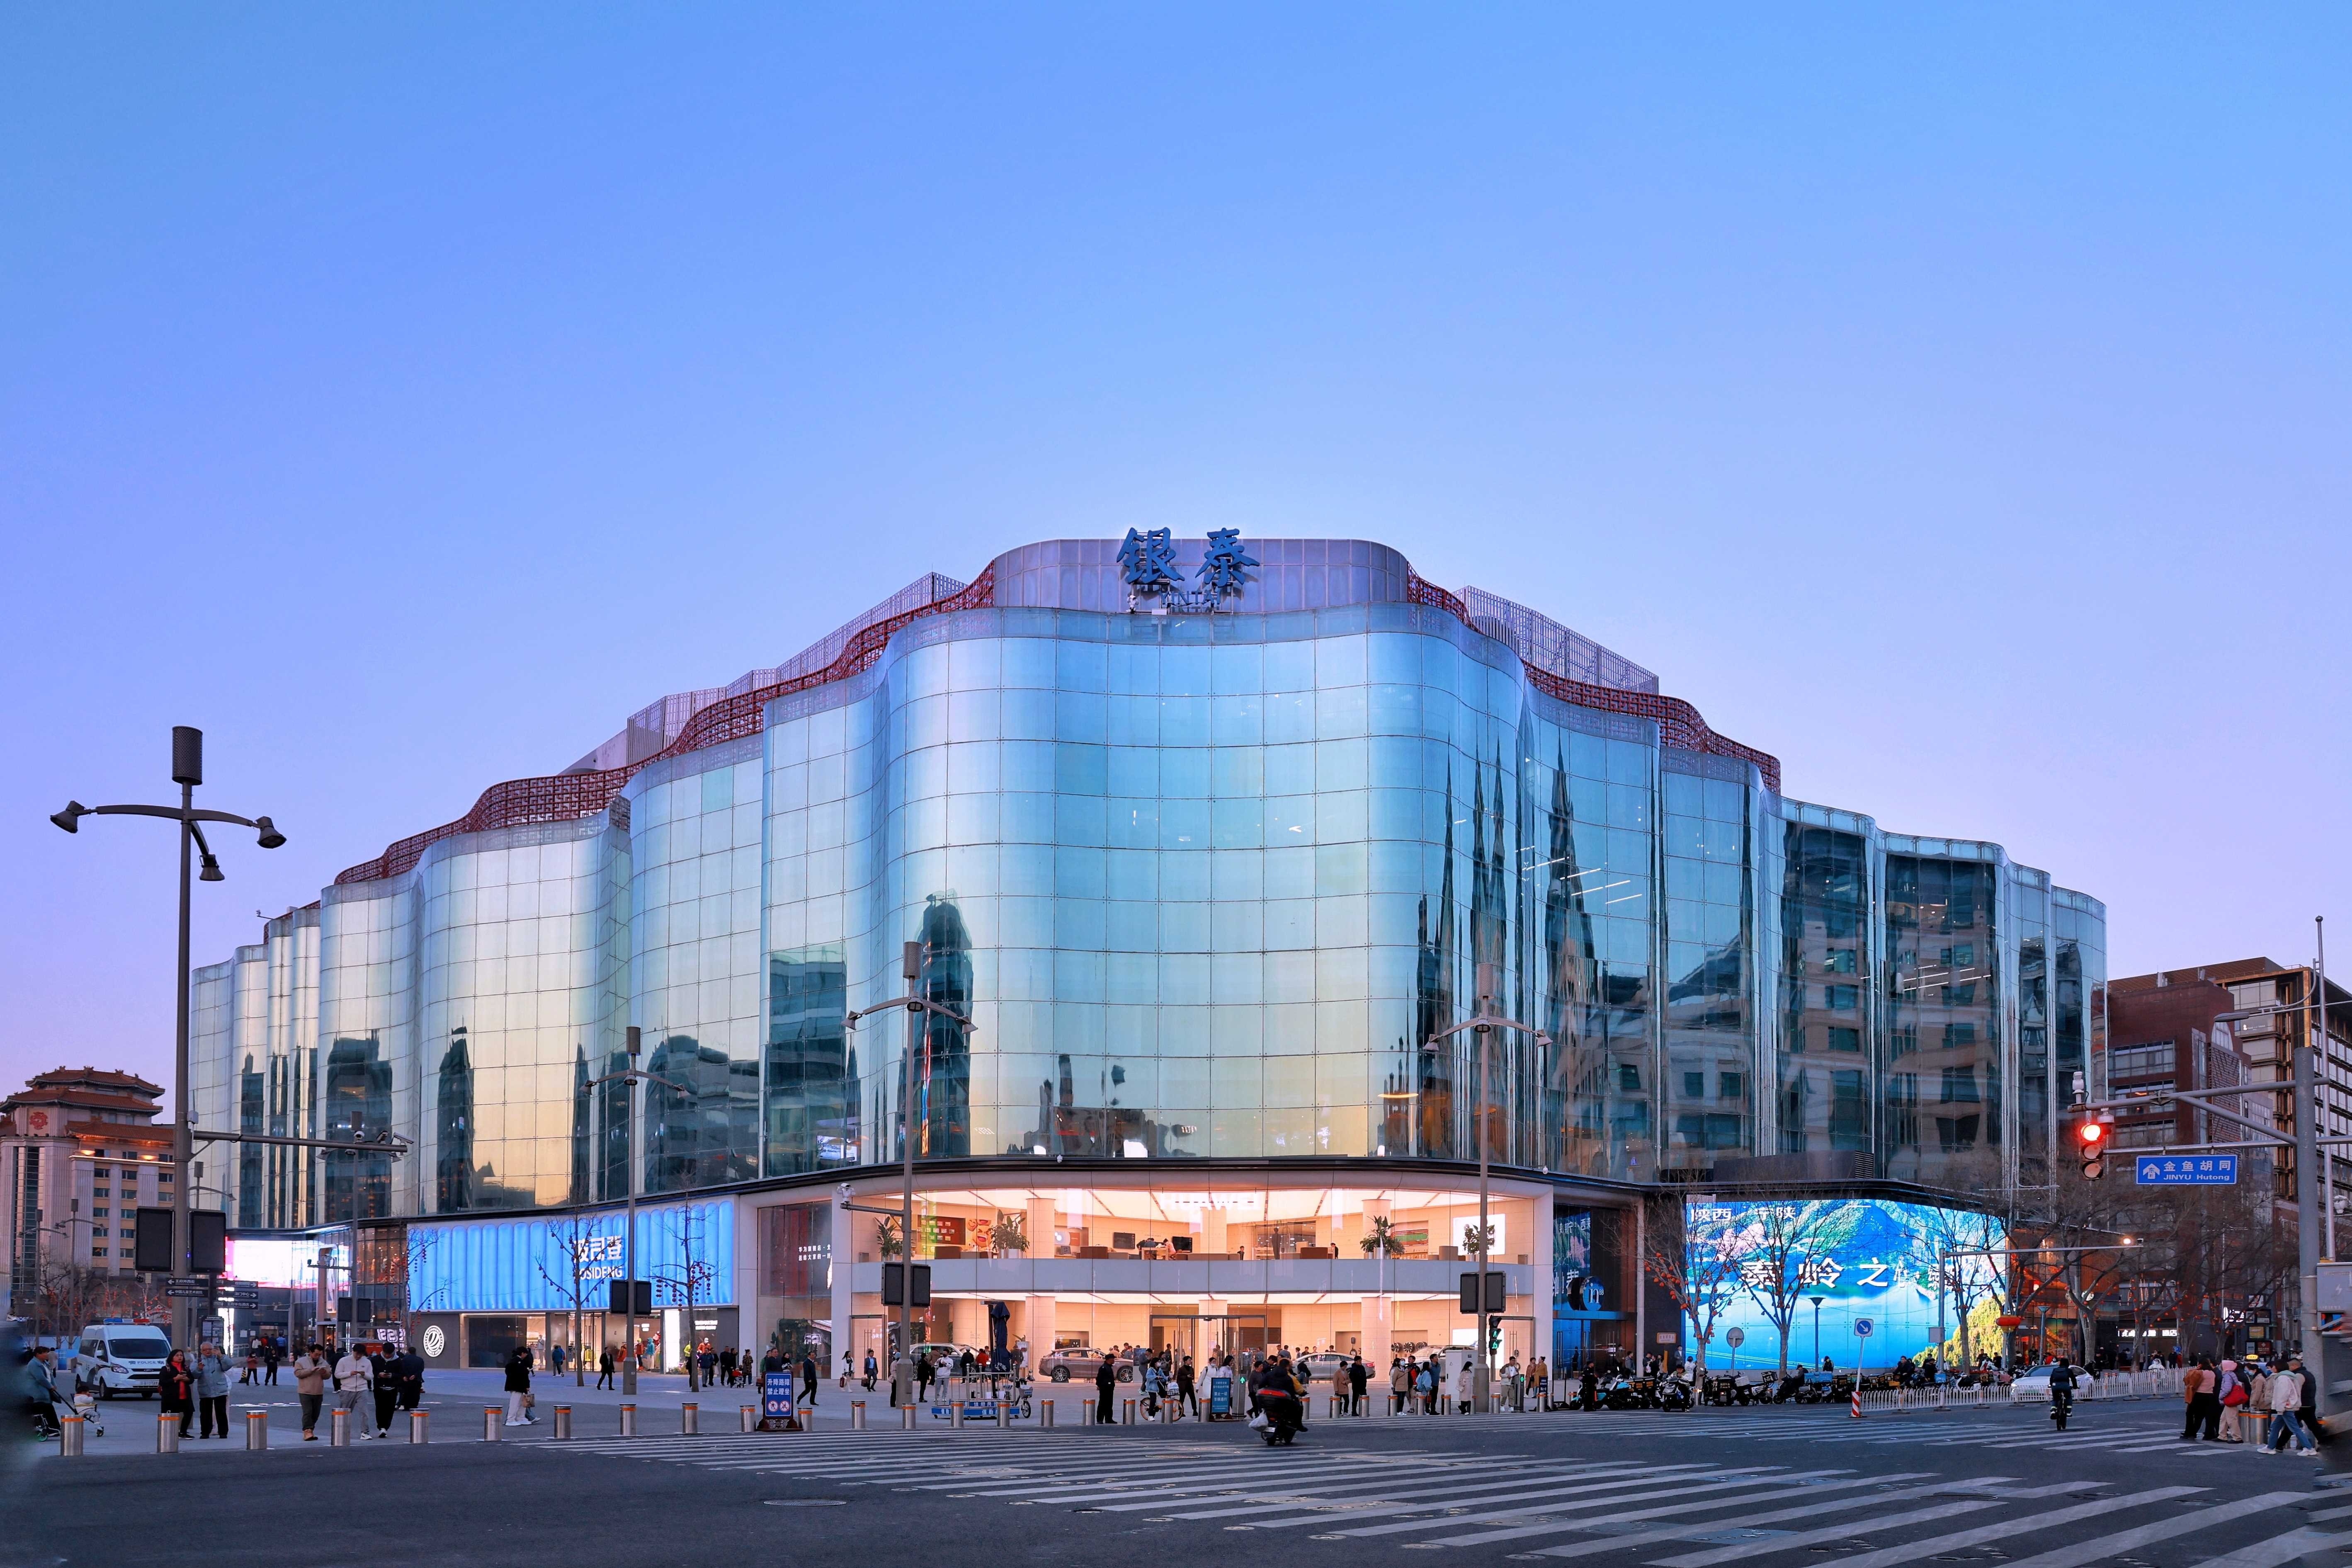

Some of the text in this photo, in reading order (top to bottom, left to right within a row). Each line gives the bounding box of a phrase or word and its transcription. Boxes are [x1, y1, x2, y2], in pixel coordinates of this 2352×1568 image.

[1117, 527, 1260, 587] 銀泰
[1161, 591, 1221, 605] YINTAI
[2163, 1161, 2231, 1171] 金鱼胡同
[1160, 1192, 1261, 1210] HUAWEI
[1691, 1208, 1732, 1221] 陕西
[574, 1266, 622, 1280] OSIDENG
